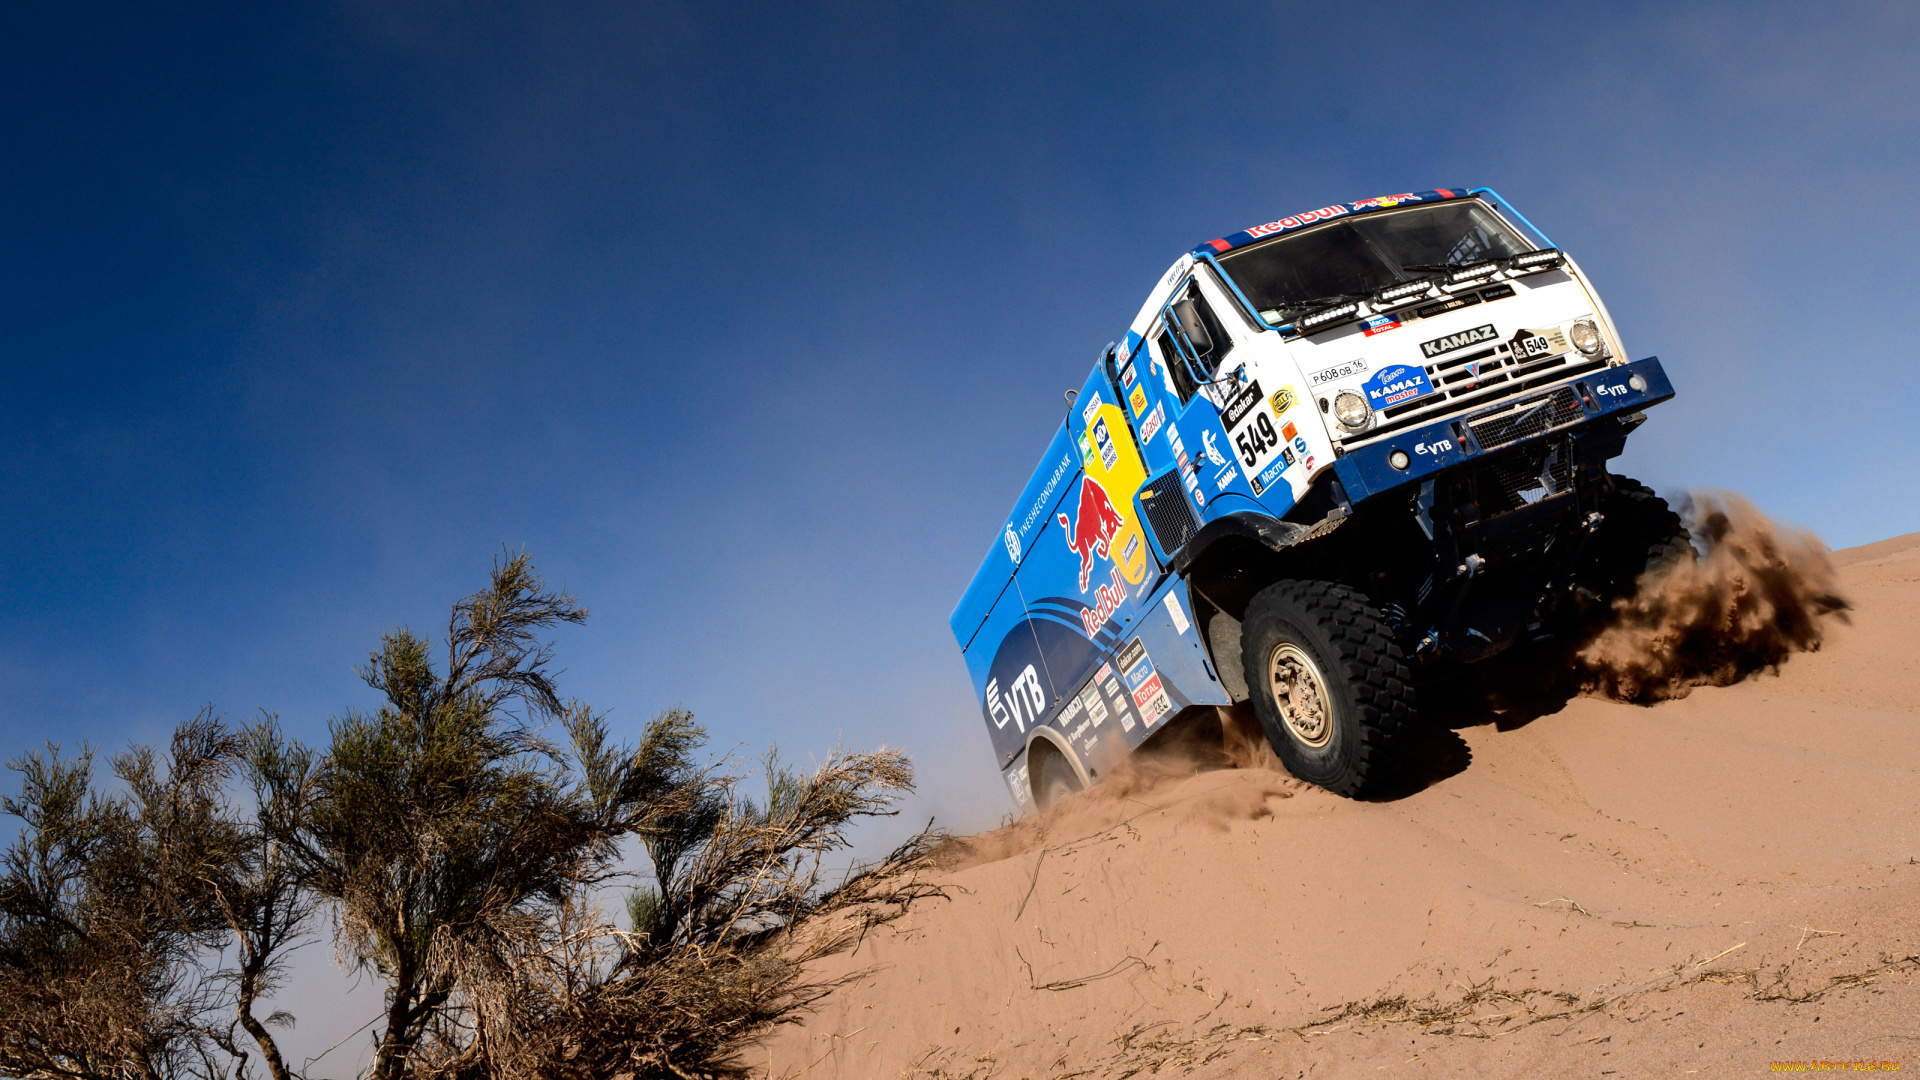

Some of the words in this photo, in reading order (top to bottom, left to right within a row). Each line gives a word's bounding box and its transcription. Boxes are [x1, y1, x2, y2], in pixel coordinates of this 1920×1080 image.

[1245, 216, 1302, 239] Red
[1297, 205, 1349, 224] Bull
[1368, 317, 1389, 328] Macro
[1371, 324, 1394, 334] TOTAL
[1425, 325, 1495, 355] KAMAZ
[1525, 336, 1549, 353] 549
[1369, 375, 1424, 400] KAMAZ
[1377, 367, 1406, 385] Team
[1386, 387, 1418, 404] master
[1607, 384, 1628, 397] VTB
[1228, 391, 1255, 422] @dakar
[1235, 411, 1278, 468] 549
[1427, 439, 1453, 456] VTB
[1216, 466, 1238, 492] KAMAZ
[1261, 460, 1285, 485] Macro
[1018, 453, 1072, 537] VNESHECONOMBANK
[1081, 590, 1108, 639] Red
[1099, 566, 1127, 617] Bull
[1119, 642, 1143, 668] dakar.com
[1130, 664, 1149, 686] Macro
[1004, 664, 1046, 734] VTB
[1136, 681, 1160, 704] TOTAL
[1057, 695, 1083, 728] WABCO
